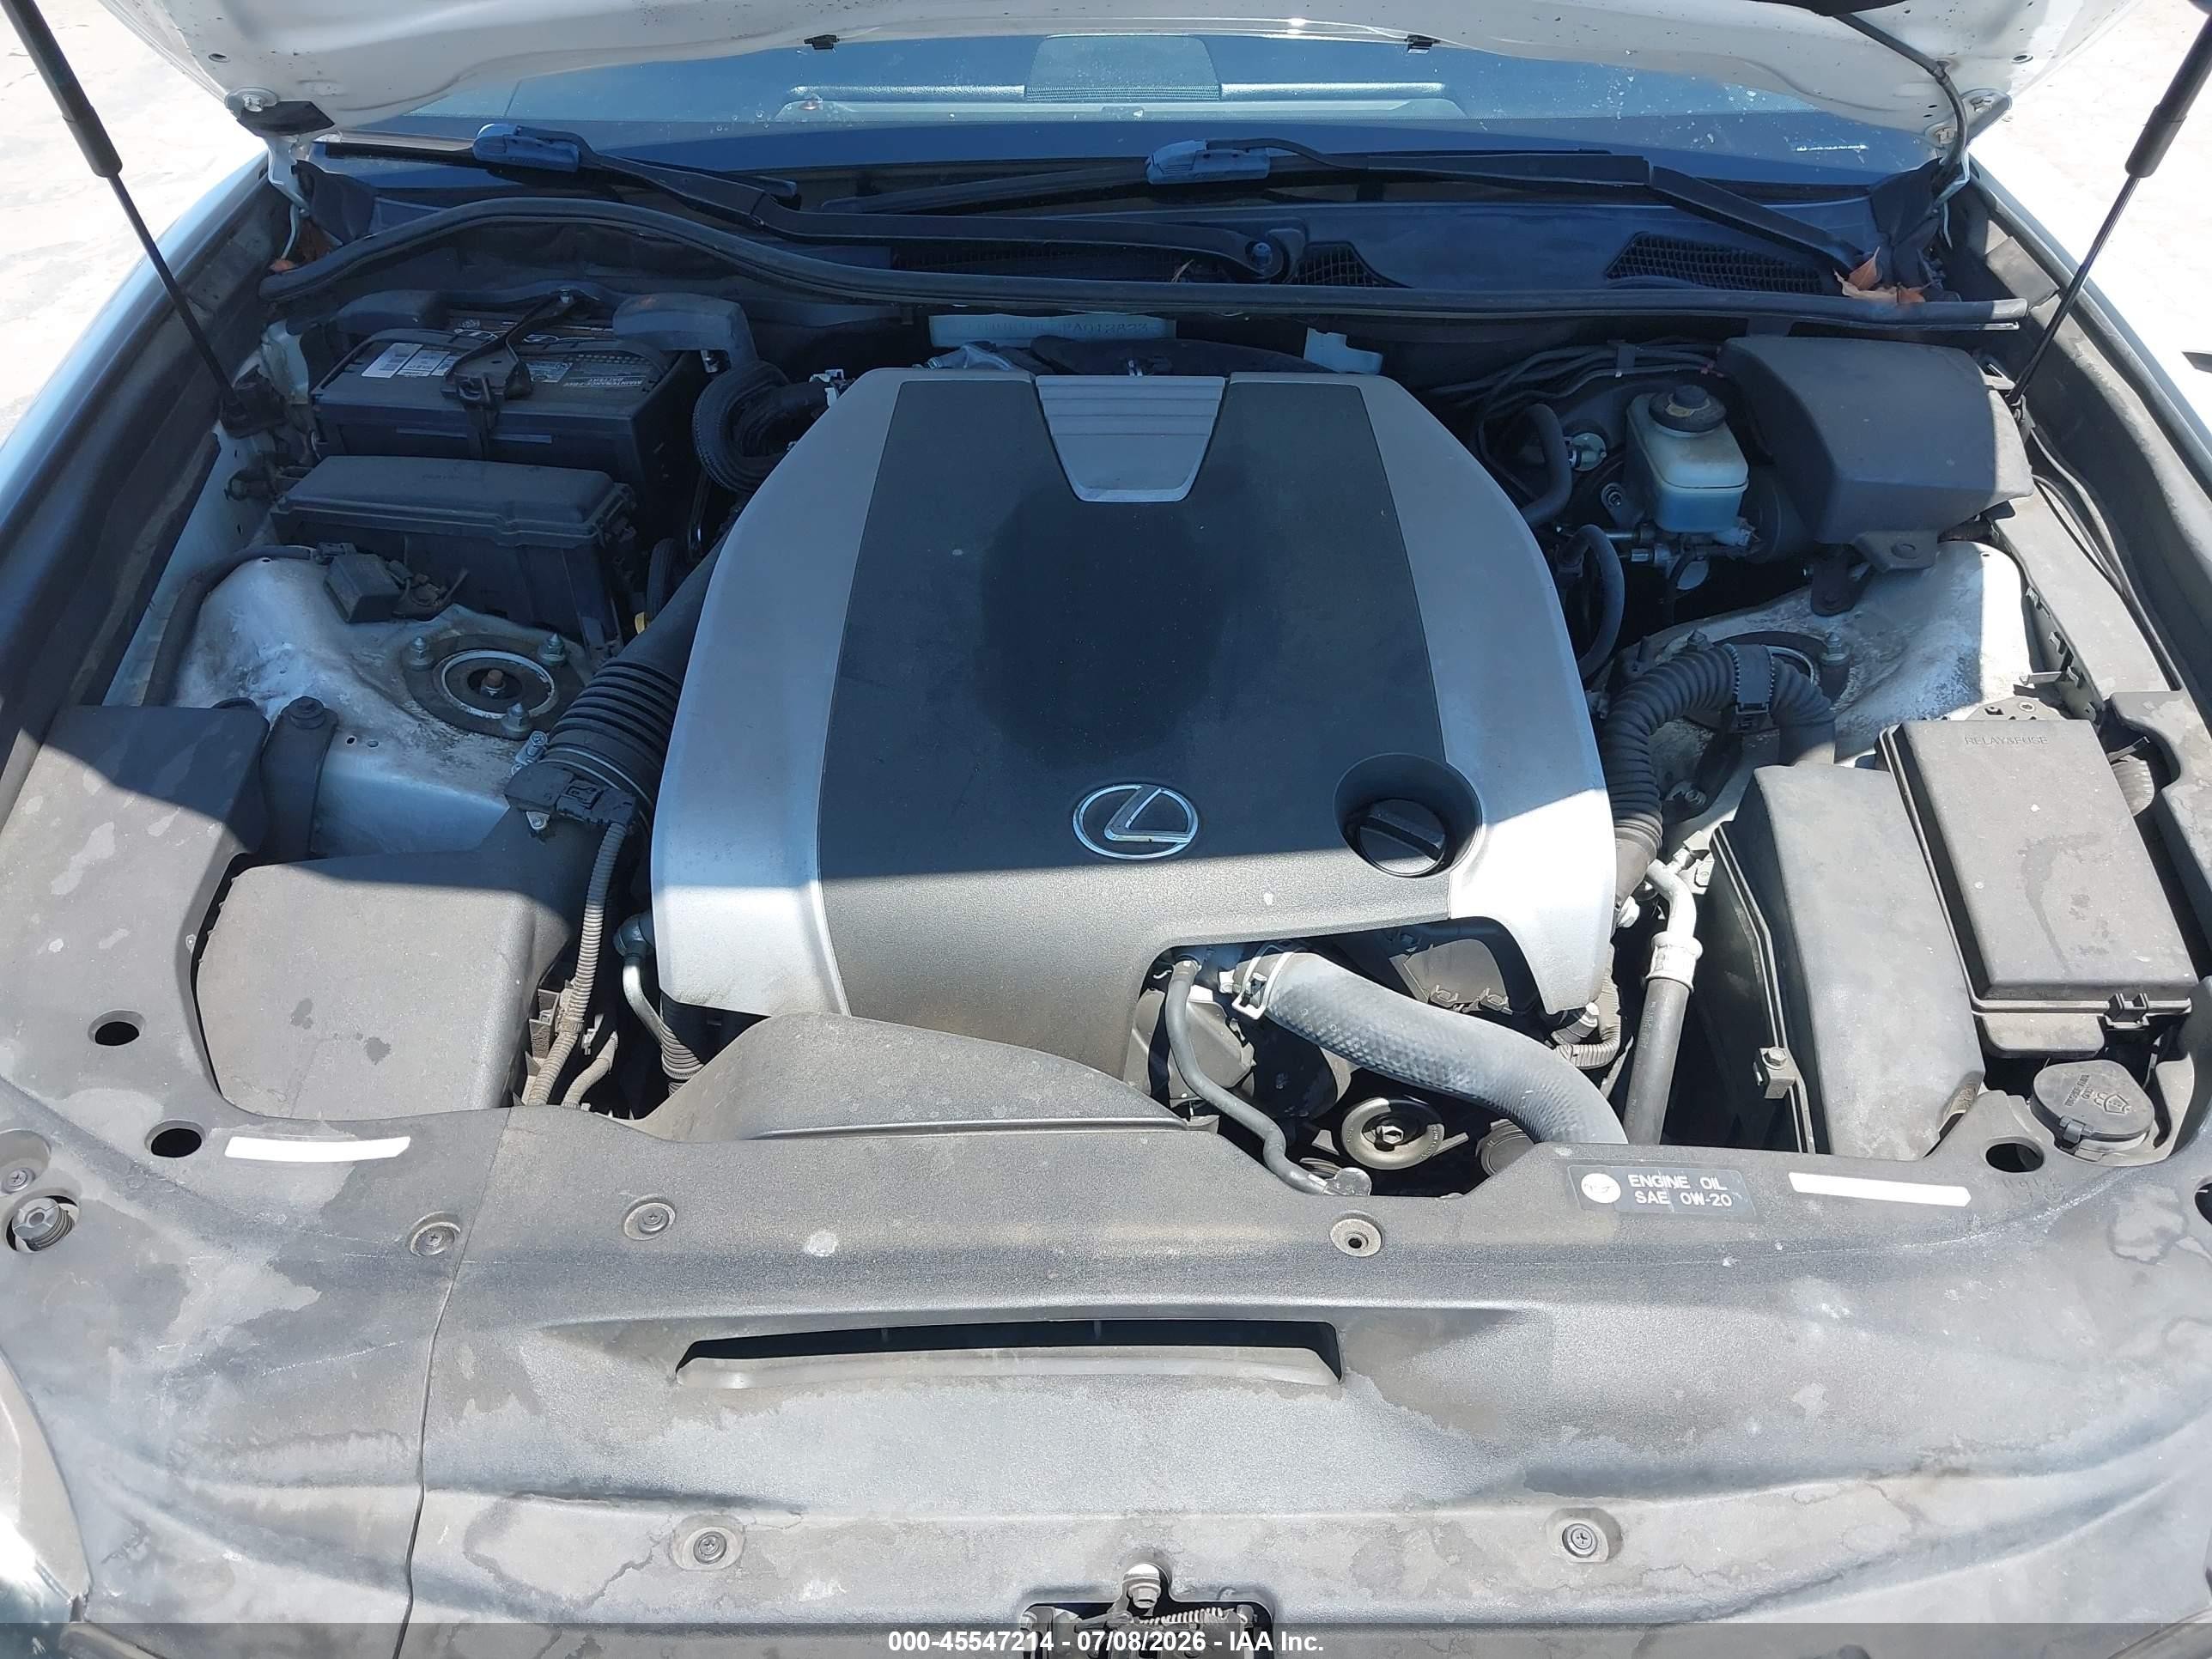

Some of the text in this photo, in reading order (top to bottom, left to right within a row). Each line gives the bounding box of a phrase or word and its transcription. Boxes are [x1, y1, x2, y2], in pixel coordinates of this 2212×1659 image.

[1627, 1174, 1728, 1191] ENGINE OIL
[1634, 1190, 1733, 1207] SAE 0W-20
